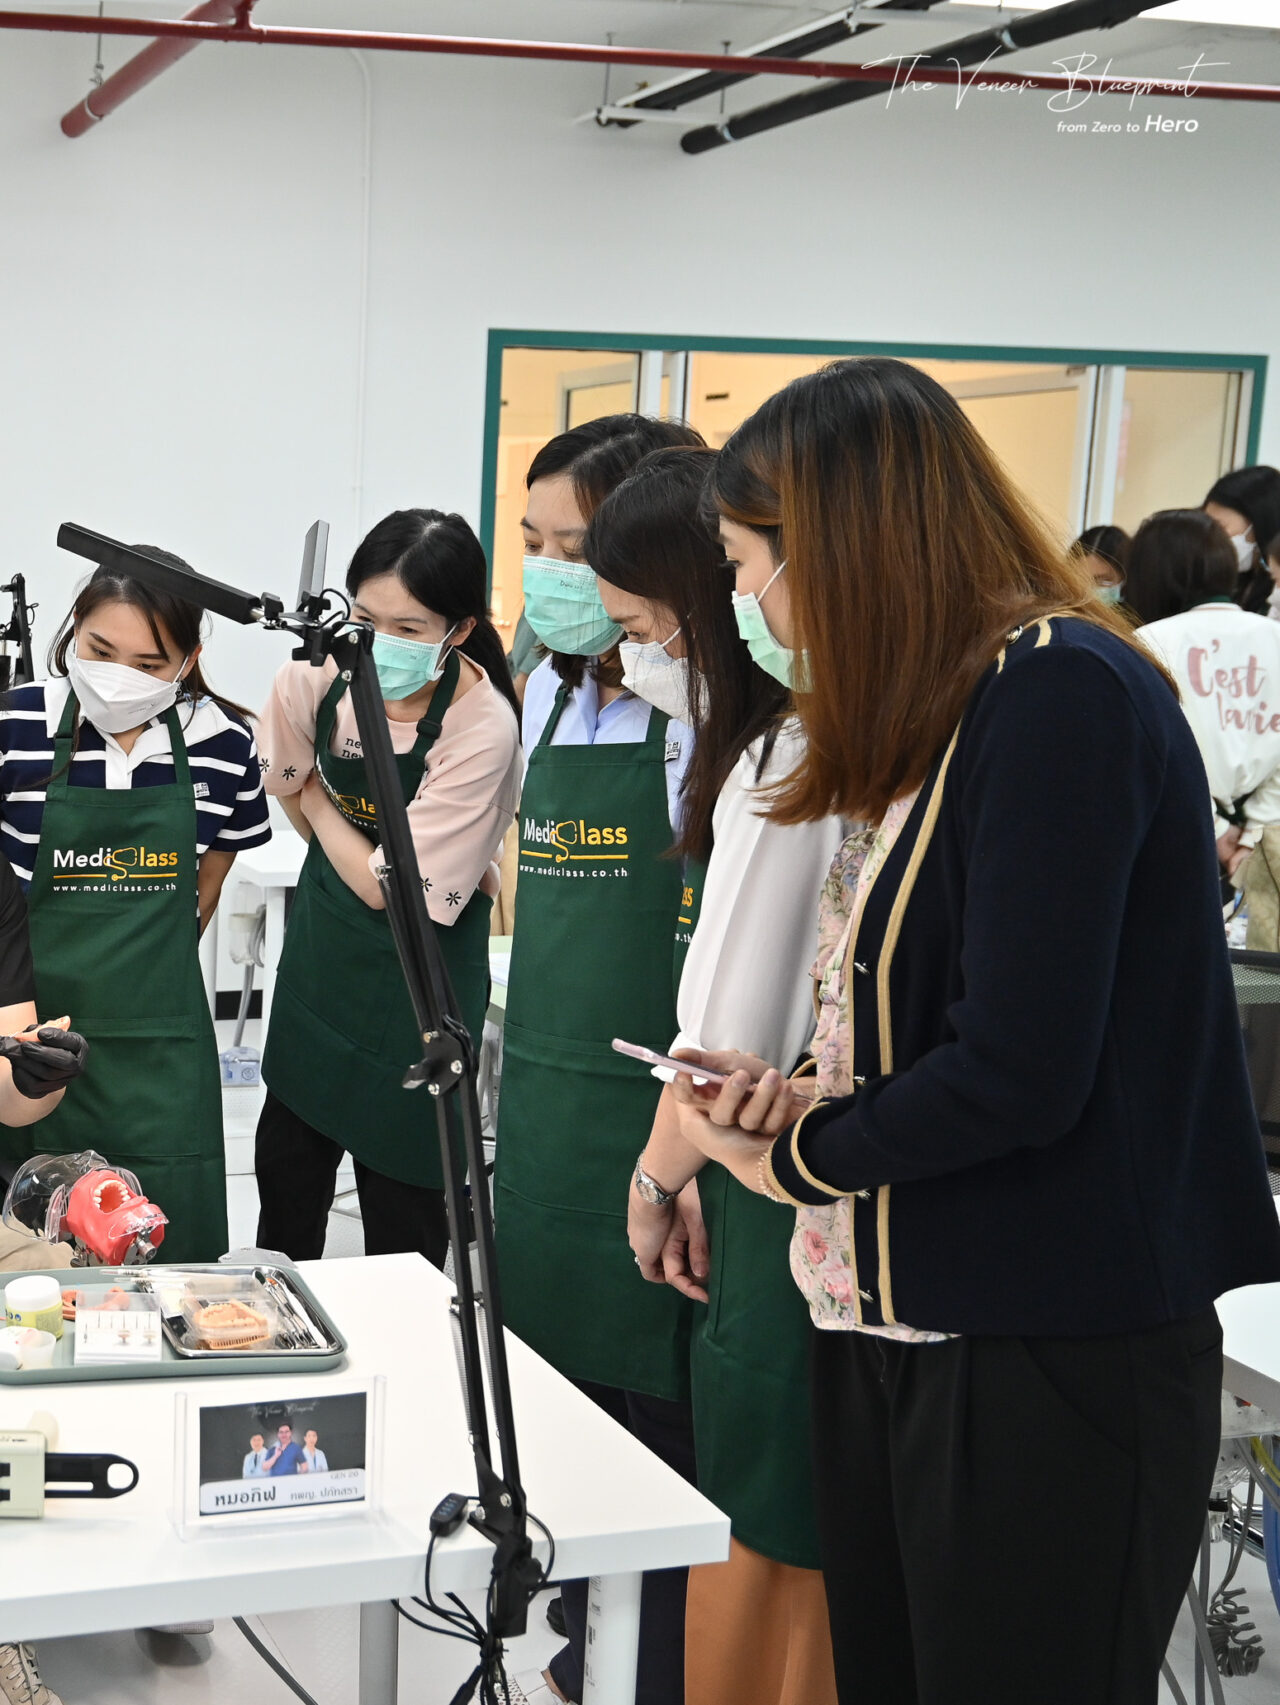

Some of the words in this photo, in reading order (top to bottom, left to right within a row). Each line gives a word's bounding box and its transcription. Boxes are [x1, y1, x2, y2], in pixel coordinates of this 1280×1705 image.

[1187, 638, 1267, 698] C'est
[53, 846, 178, 881] MediClass
[519, 864, 629, 878] www.mediclass.co.th
[53, 882, 177, 893] www.mediclass.co.th
